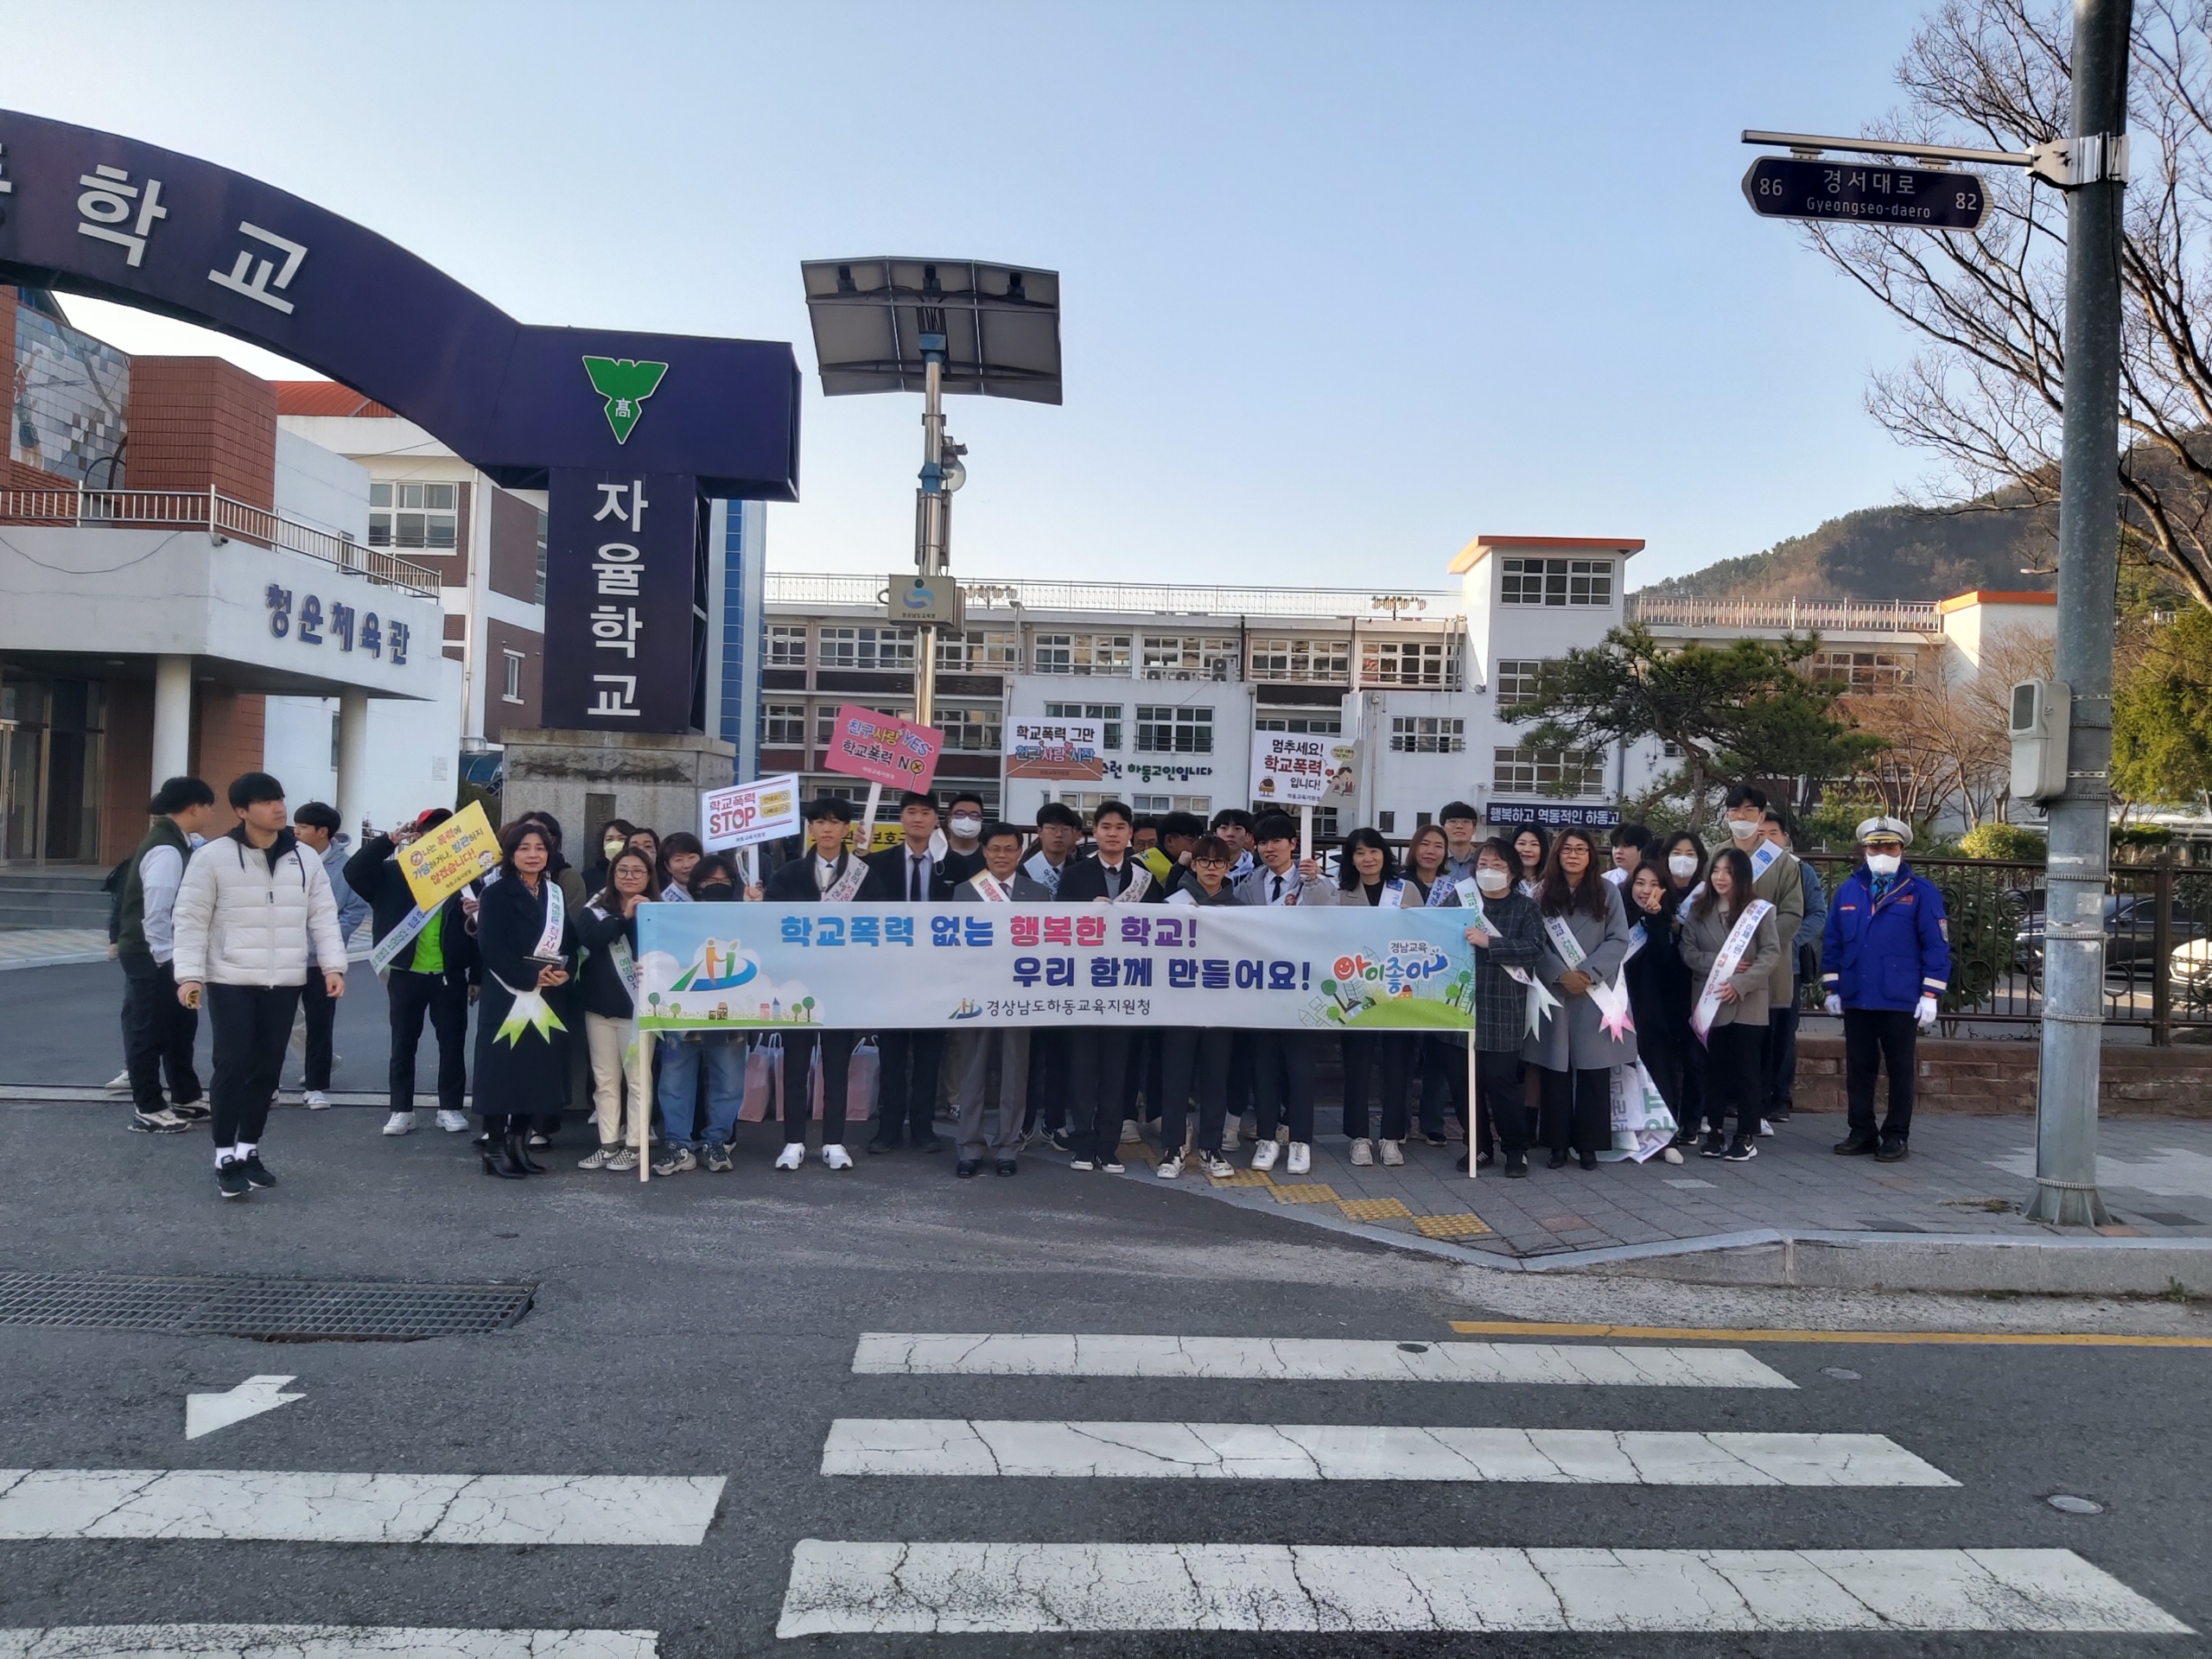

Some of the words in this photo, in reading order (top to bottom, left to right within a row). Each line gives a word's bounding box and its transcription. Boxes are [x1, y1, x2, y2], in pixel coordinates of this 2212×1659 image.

[1759, 178, 1783, 196] 86
[1823, 169, 1916, 194] 경서대로
[1807, 197, 1930, 219] Gyeongseo-daero
[1955, 193, 1977, 210] 82
[588, 481, 649, 719] 자율학교
[265, 582, 410, 666] 청운체육관
[902, 729, 931, 756] YES
[1016, 725, 1066, 741] 학교폭력
[1070, 728, 1096, 742] 그만
[843, 740, 894, 766] 학교폭력
[1015, 745, 1067, 763] 친구사랑
[1070, 747, 1096, 764] 시작
[1273, 740, 1324, 757] 멈추세요!
[1128, 763, 1213, 783] 하동고인입니다
[1264, 754, 1323, 777] 학교폭력
[1290, 778, 1321, 791] 입니다!
[709, 792, 756, 811] 학교폭력
[709, 806, 756, 835] STOP
[1490, 807, 1535, 823] 행복하고
[1538, 809, 1583, 823] 역동적인
[1586, 810, 1619, 824] 하동고
[422, 843, 436, 857] 나는
[436, 824, 462, 846] 폭력에
[451, 827, 484, 854] 방관하지
[430, 848, 478, 886] 않겠습니다!
[781, 916, 914, 948] 학교폭력
[931, 916, 994, 947] 없는
[1010, 916, 1107, 947] 행복한
[1121, 917, 1198, 948] 학교!
[1391, 943, 1427, 953] 경남교육
[1013, 957, 1075, 988] 우리
[1091, 957, 1153, 988] 함께
[1168, 957, 1311, 991] 만들어요!
[1333, 954, 1448, 995] 아이좋아
[986, 999, 1151, 1016] 경상남도하동교육지원청
